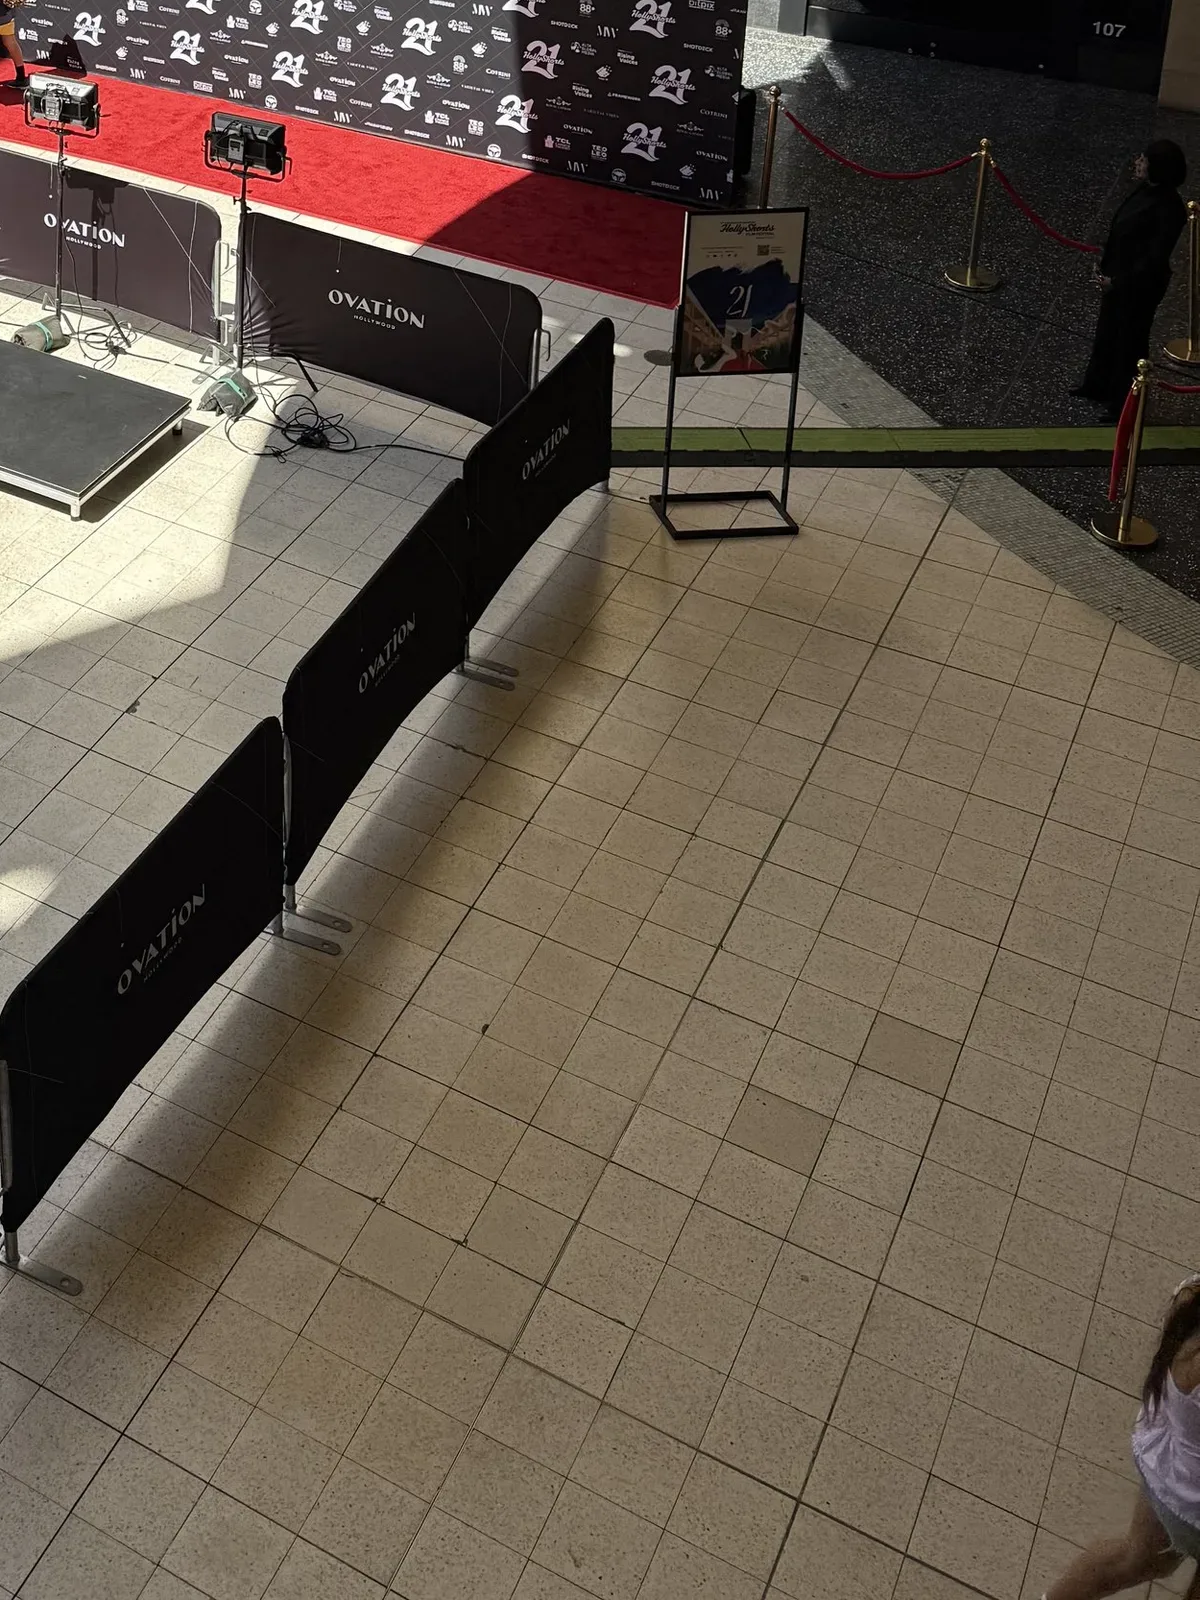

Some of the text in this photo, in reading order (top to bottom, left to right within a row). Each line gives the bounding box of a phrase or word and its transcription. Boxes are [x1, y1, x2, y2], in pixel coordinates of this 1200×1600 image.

[73, 12, 102, 47] 21
[170, 30, 200, 65] 21
[401, 18, 438, 55] 21
[1093, 21, 1126, 38] 107
[271, 51, 304, 88] 21
[521, 40, 560, 79] 21
[381, 73, 417, 111] 21
[649, 65, 691, 105] 21
[495, 95, 534, 133] 21
[555, 137, 571, 145] TCL
[621, 122, 662, 161] 21
[720, 222, 775, 236] HollyShorts
[726, 284, 753, 318] 21
[354, 314, 396, 330] HOLLYWOOD
